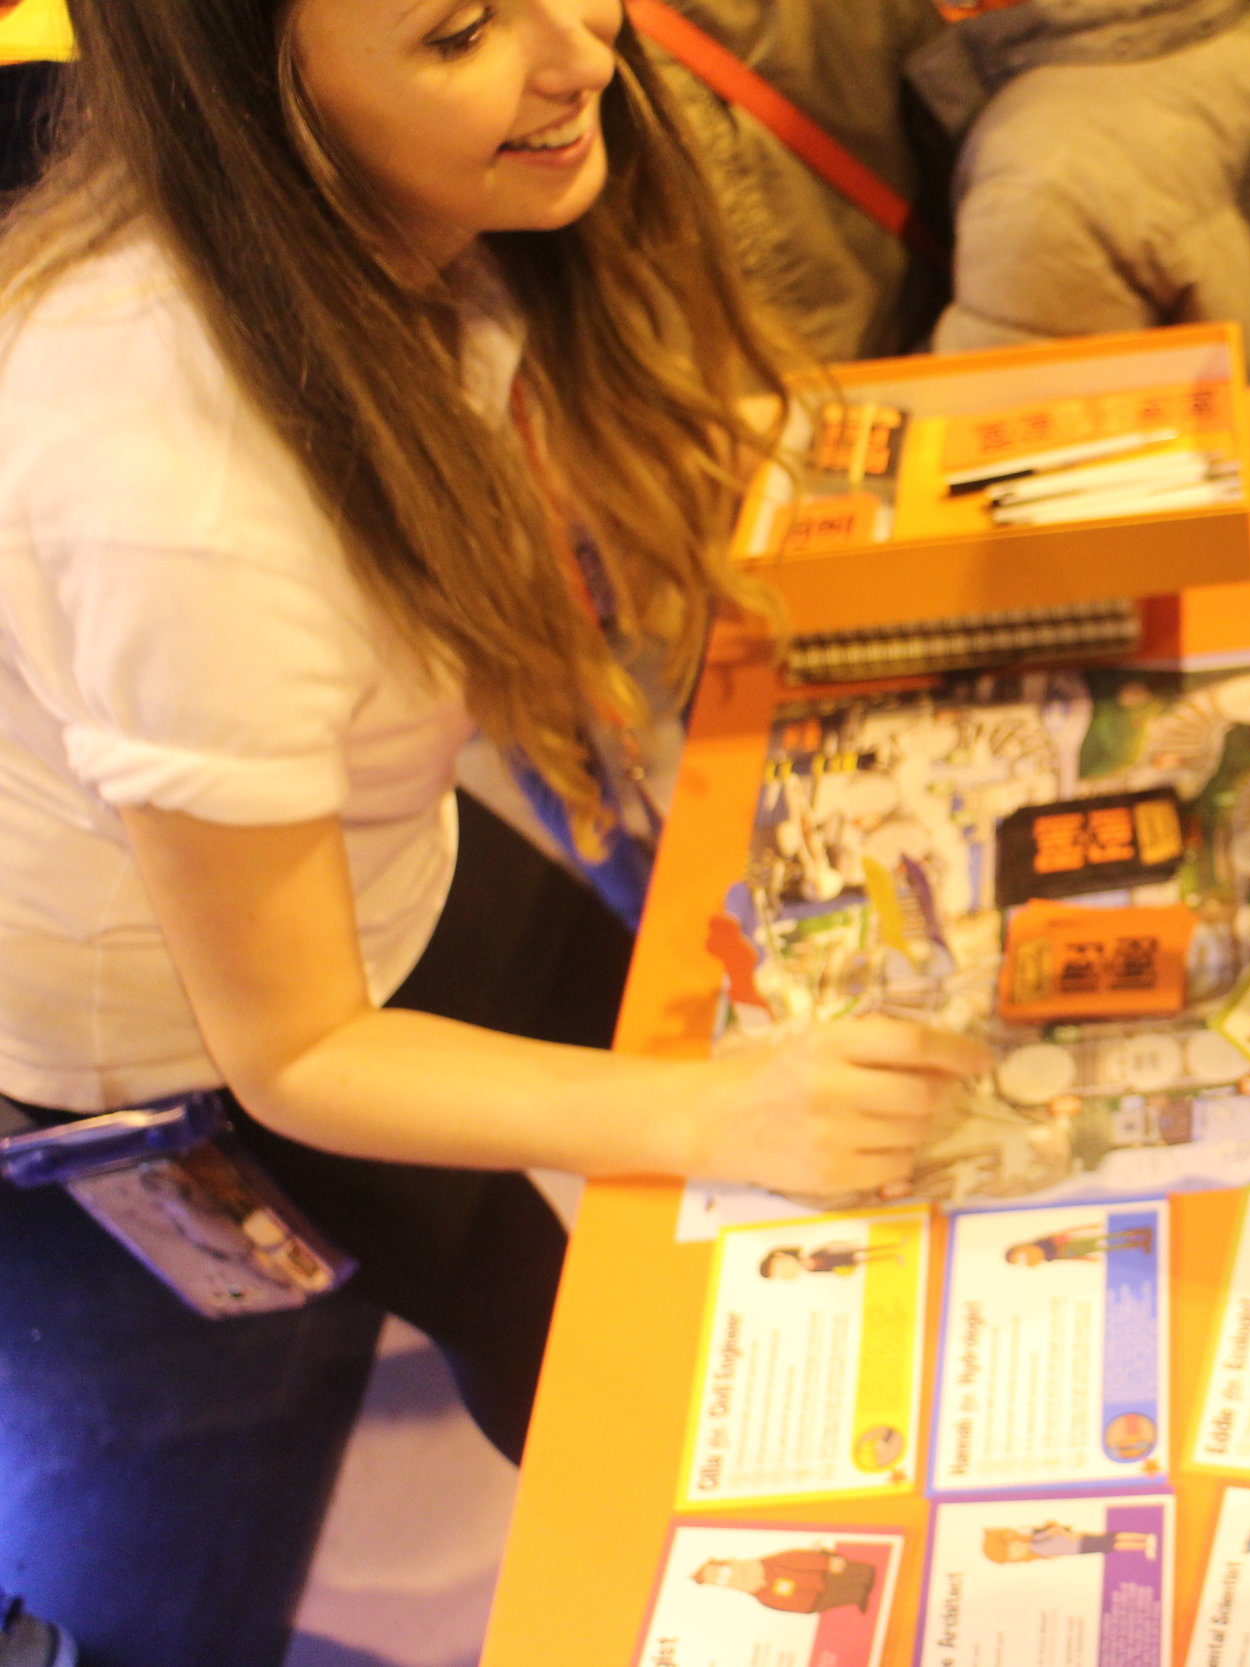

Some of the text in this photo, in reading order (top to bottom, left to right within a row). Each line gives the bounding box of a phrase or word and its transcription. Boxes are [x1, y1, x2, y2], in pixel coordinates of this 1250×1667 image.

[715, 1310, 742, 1379] Engineer
[957, 1299, 984, 1387] Hydrologist
[709, 1382, 734, 1419] Civil
[1205, 1409, 1233, 1456] Eddie
[948, 1417, 973, 1477] Hannah
[937, 1572, 964, 1649] Architect
[1211, 1561, 1243, 1625] Scientist
